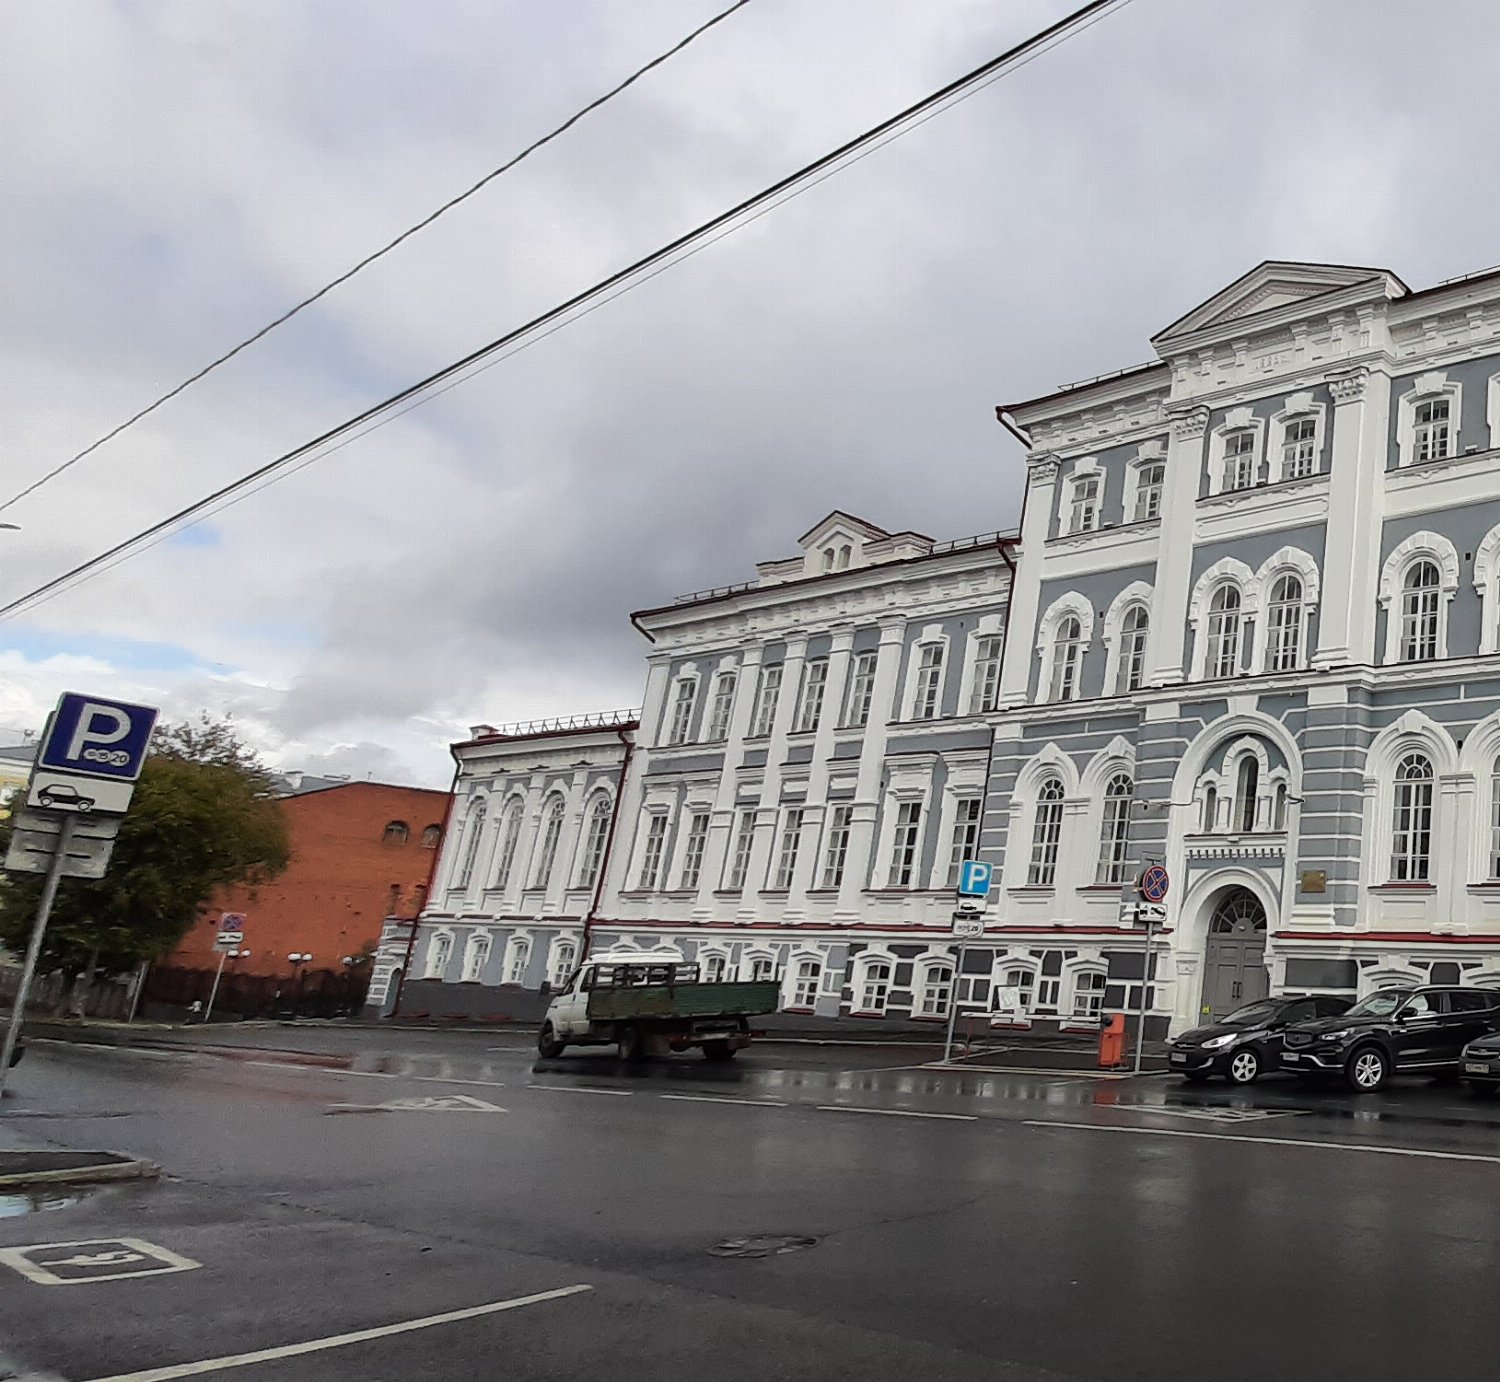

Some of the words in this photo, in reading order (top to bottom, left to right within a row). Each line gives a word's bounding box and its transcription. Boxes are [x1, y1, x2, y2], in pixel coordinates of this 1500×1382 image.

[66, 702, 131, 761] P
[110, 753, 128, 763] 20
[968, 864, 989, 891] P
